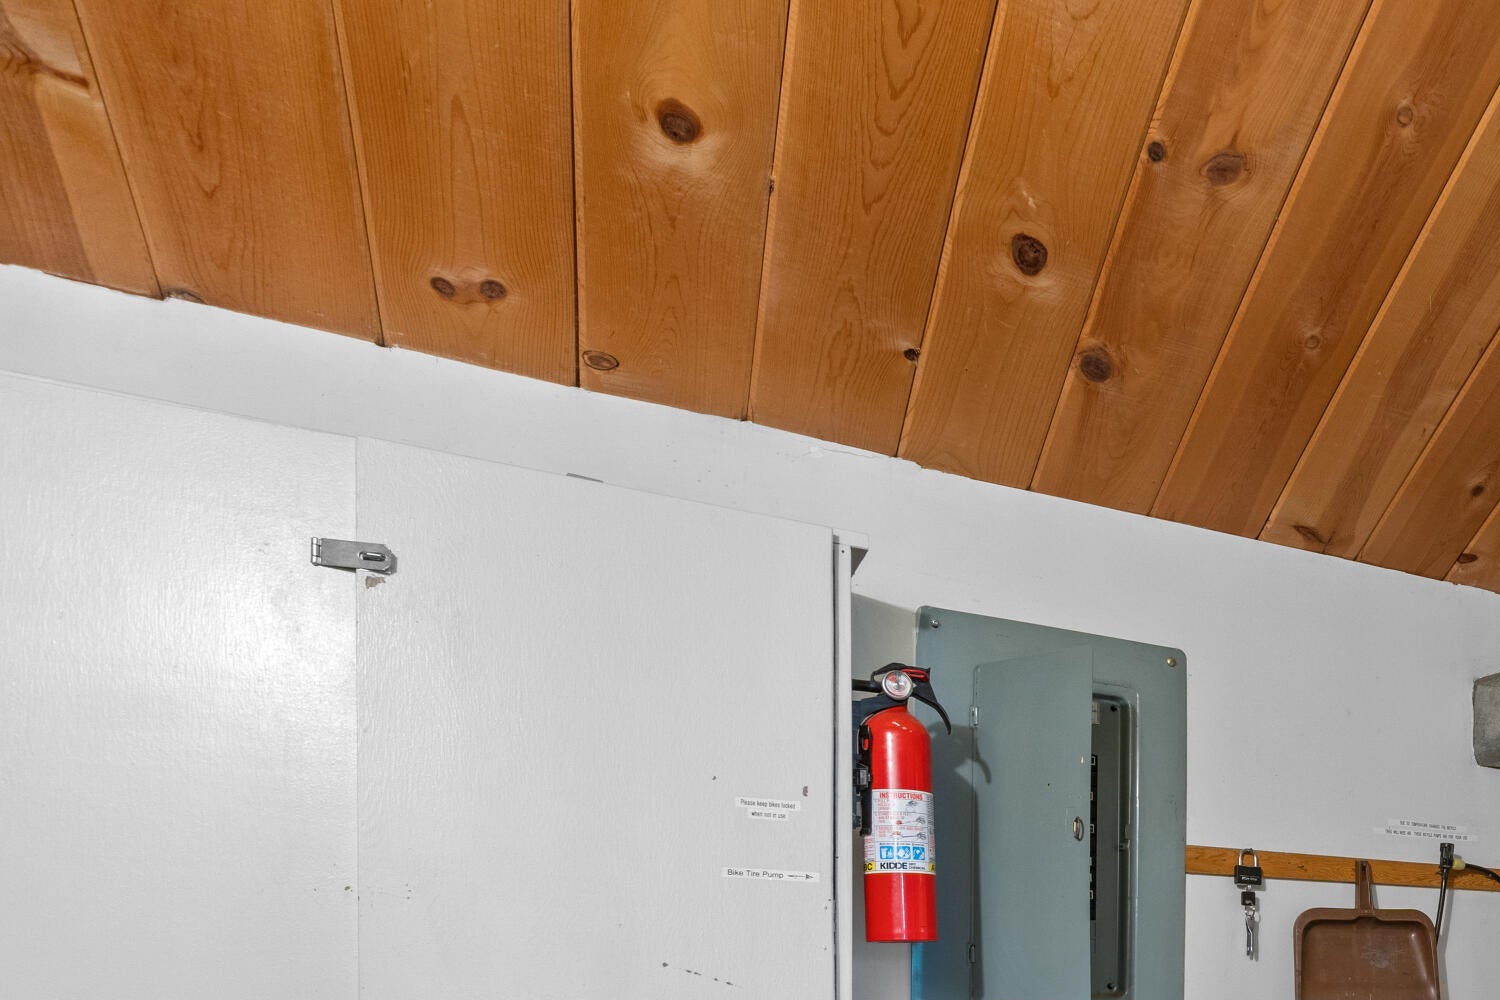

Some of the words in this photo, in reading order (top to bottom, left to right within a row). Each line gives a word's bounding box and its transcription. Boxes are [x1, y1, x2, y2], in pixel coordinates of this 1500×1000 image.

[880, 862, 907, 870] KIDDE
[728, 868, 743, 876] Bike
[762, 871, 783, 879] Pump
